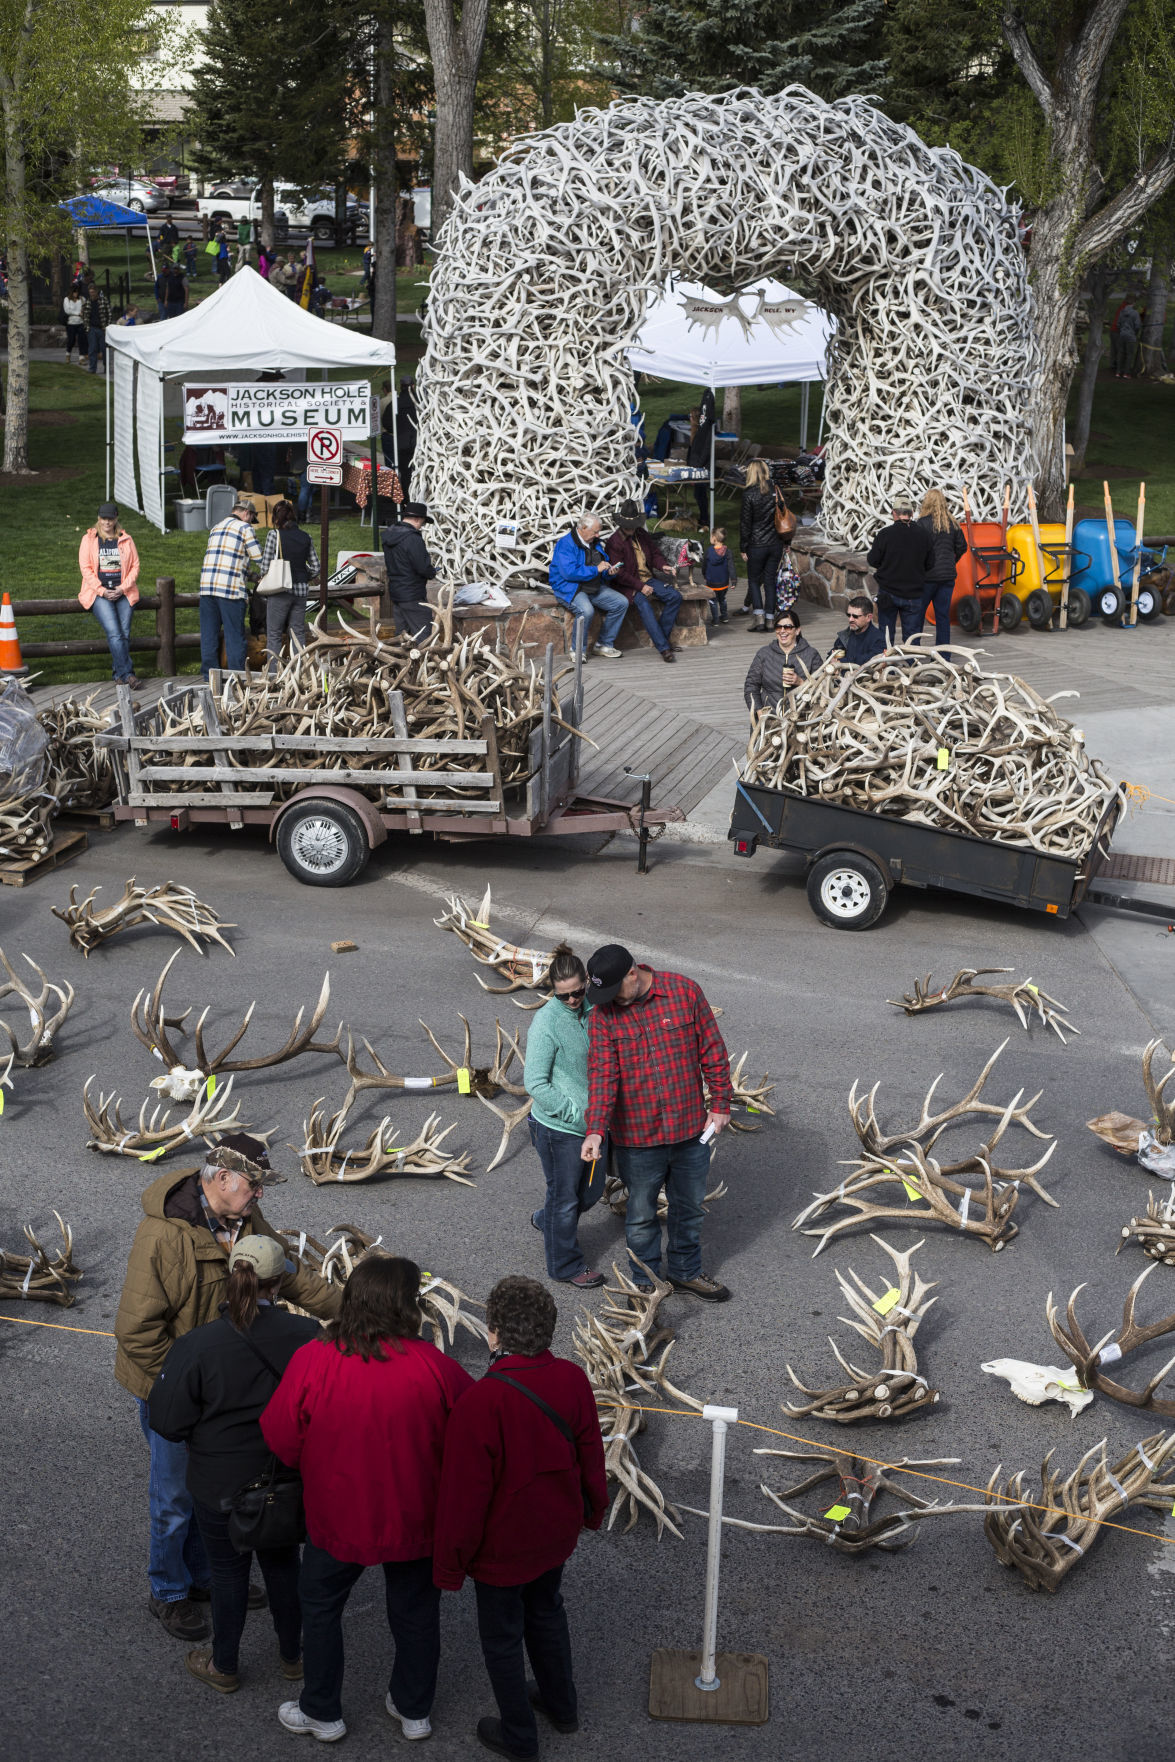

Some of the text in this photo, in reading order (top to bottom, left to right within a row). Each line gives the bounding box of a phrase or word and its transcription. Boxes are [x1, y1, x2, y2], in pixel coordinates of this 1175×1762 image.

[231, 386, 368, 400] JACKSON HOLE
[307, 399, 355, 407] SOCIETY
[231, 407, 366, 427] MUSEUM
[320, 437, 332, 455] P
[331, 568, 350, 583] WAY
